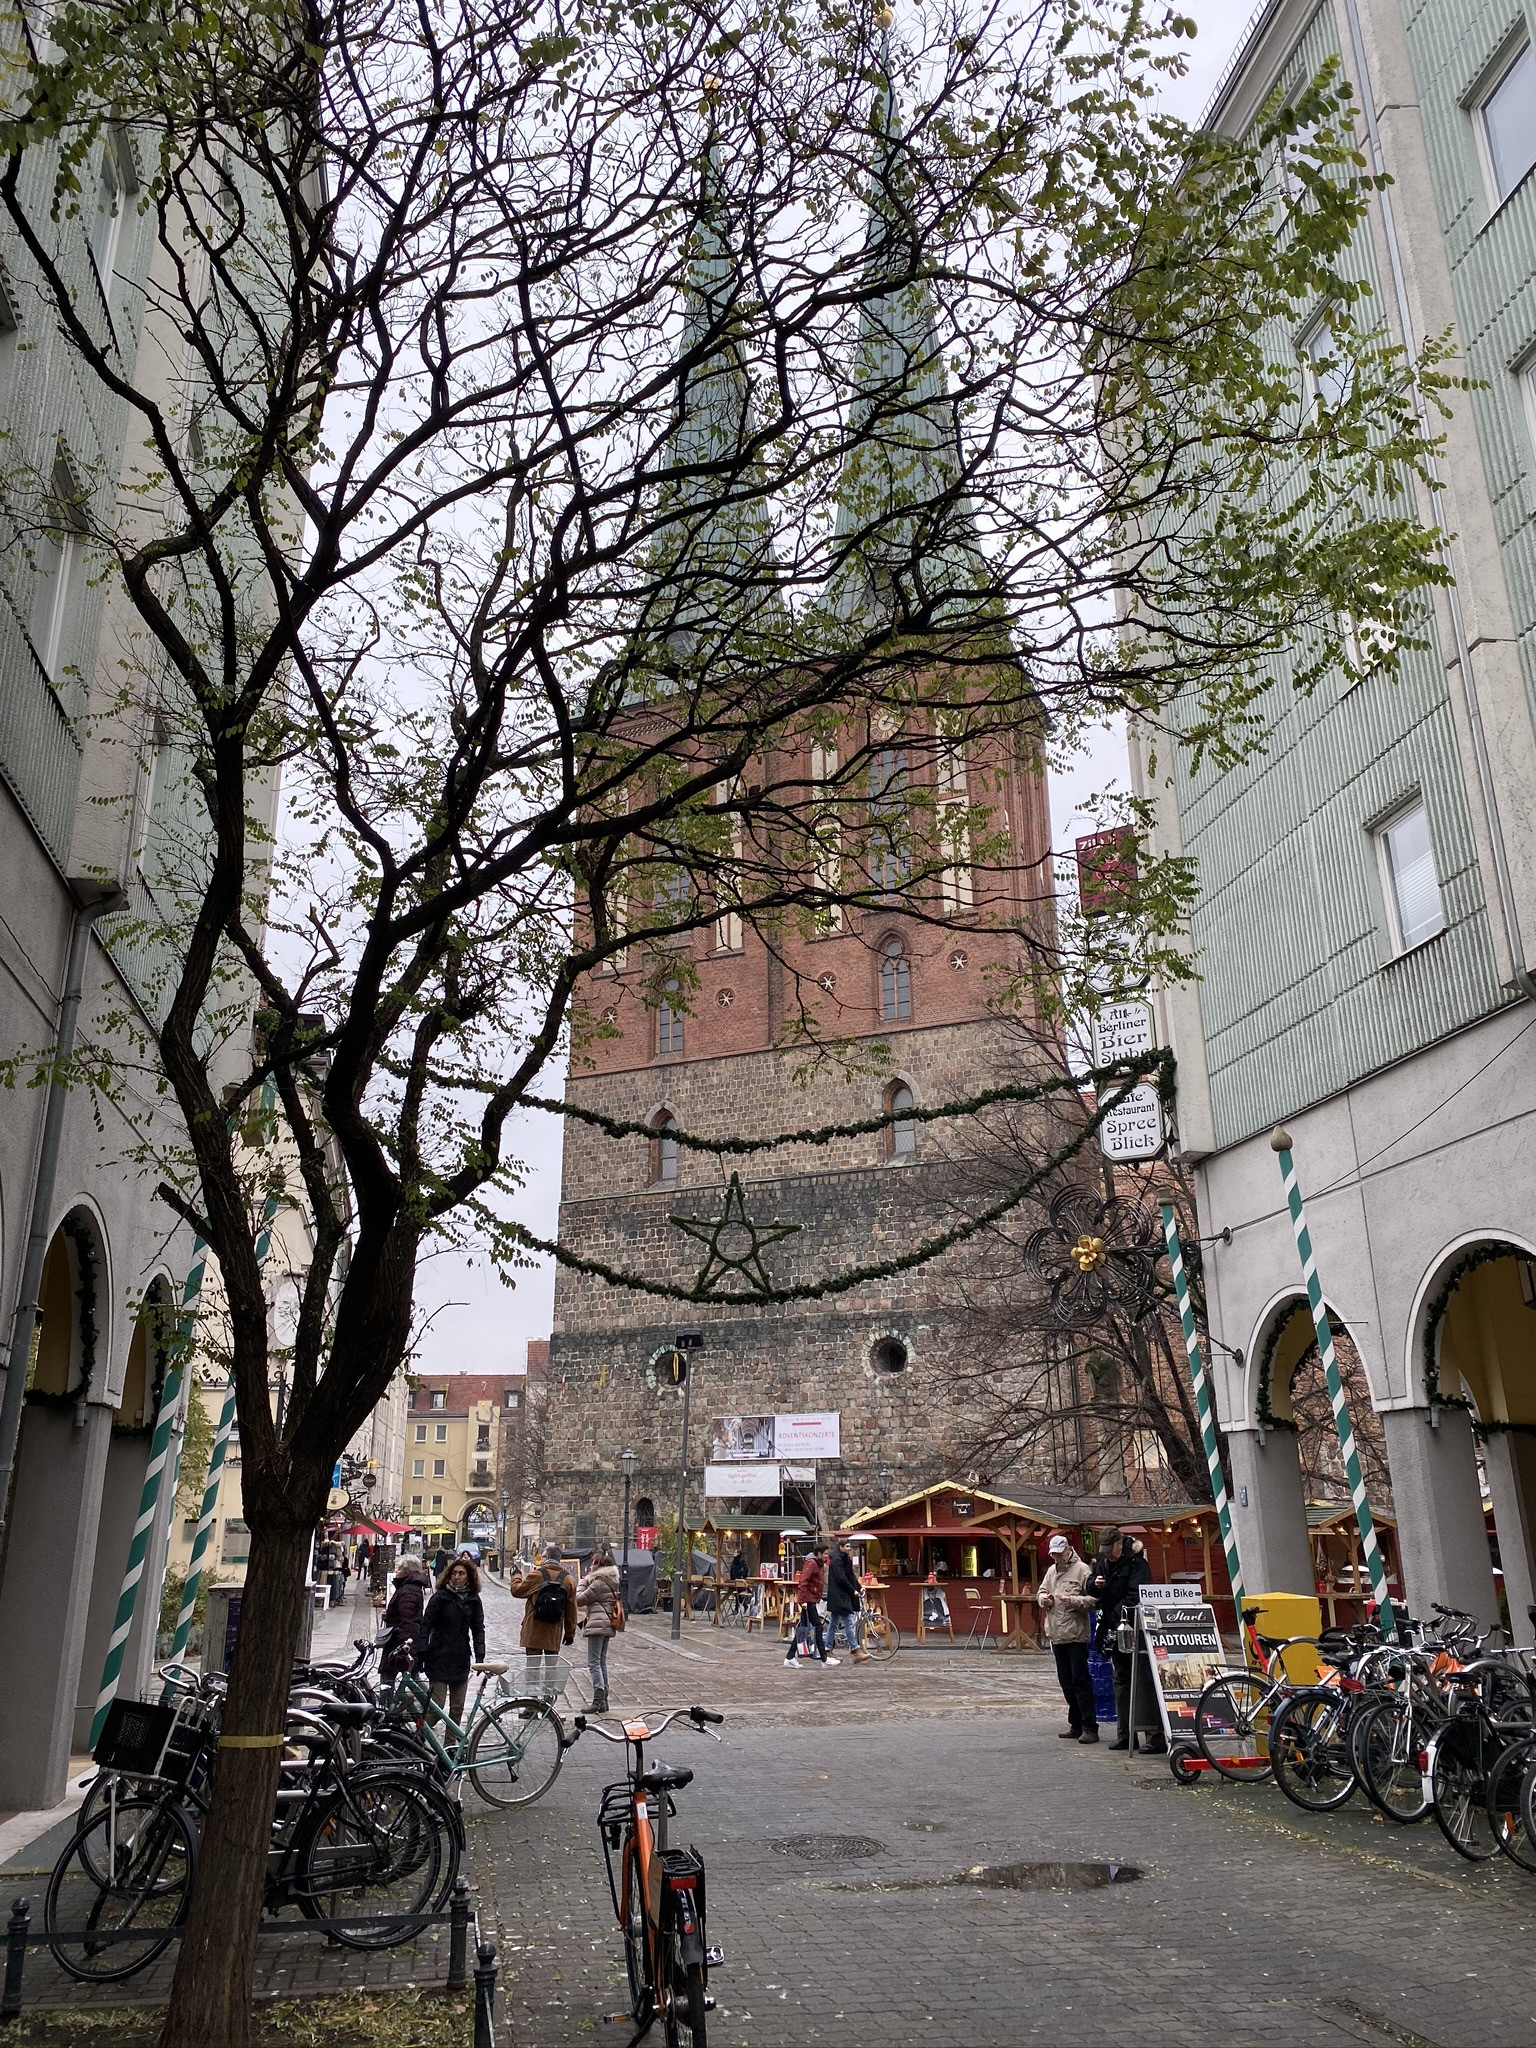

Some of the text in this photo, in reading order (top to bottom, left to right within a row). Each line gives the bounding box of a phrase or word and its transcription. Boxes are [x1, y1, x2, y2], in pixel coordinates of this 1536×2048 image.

[1097, 1019, 1147, 1034] Berliner
[1099, 1033, 1147, 1049] Bier
[1101, 1047, 1150, 1064] Stube
[1107, 1118, 1157, 1136] Spree
[1110, 1134, 1155, 1151] Blick
[778, 1431, 835, 1439] ADVENTSKONZERTE
[1140, 1588, 1162, 1598] Rent
[1173, 1588, 1194, 1598] Bike
[1166, 1610, 1206, 1622] Start
[1152, 1633, 1217, 1646] RADTOUREN
